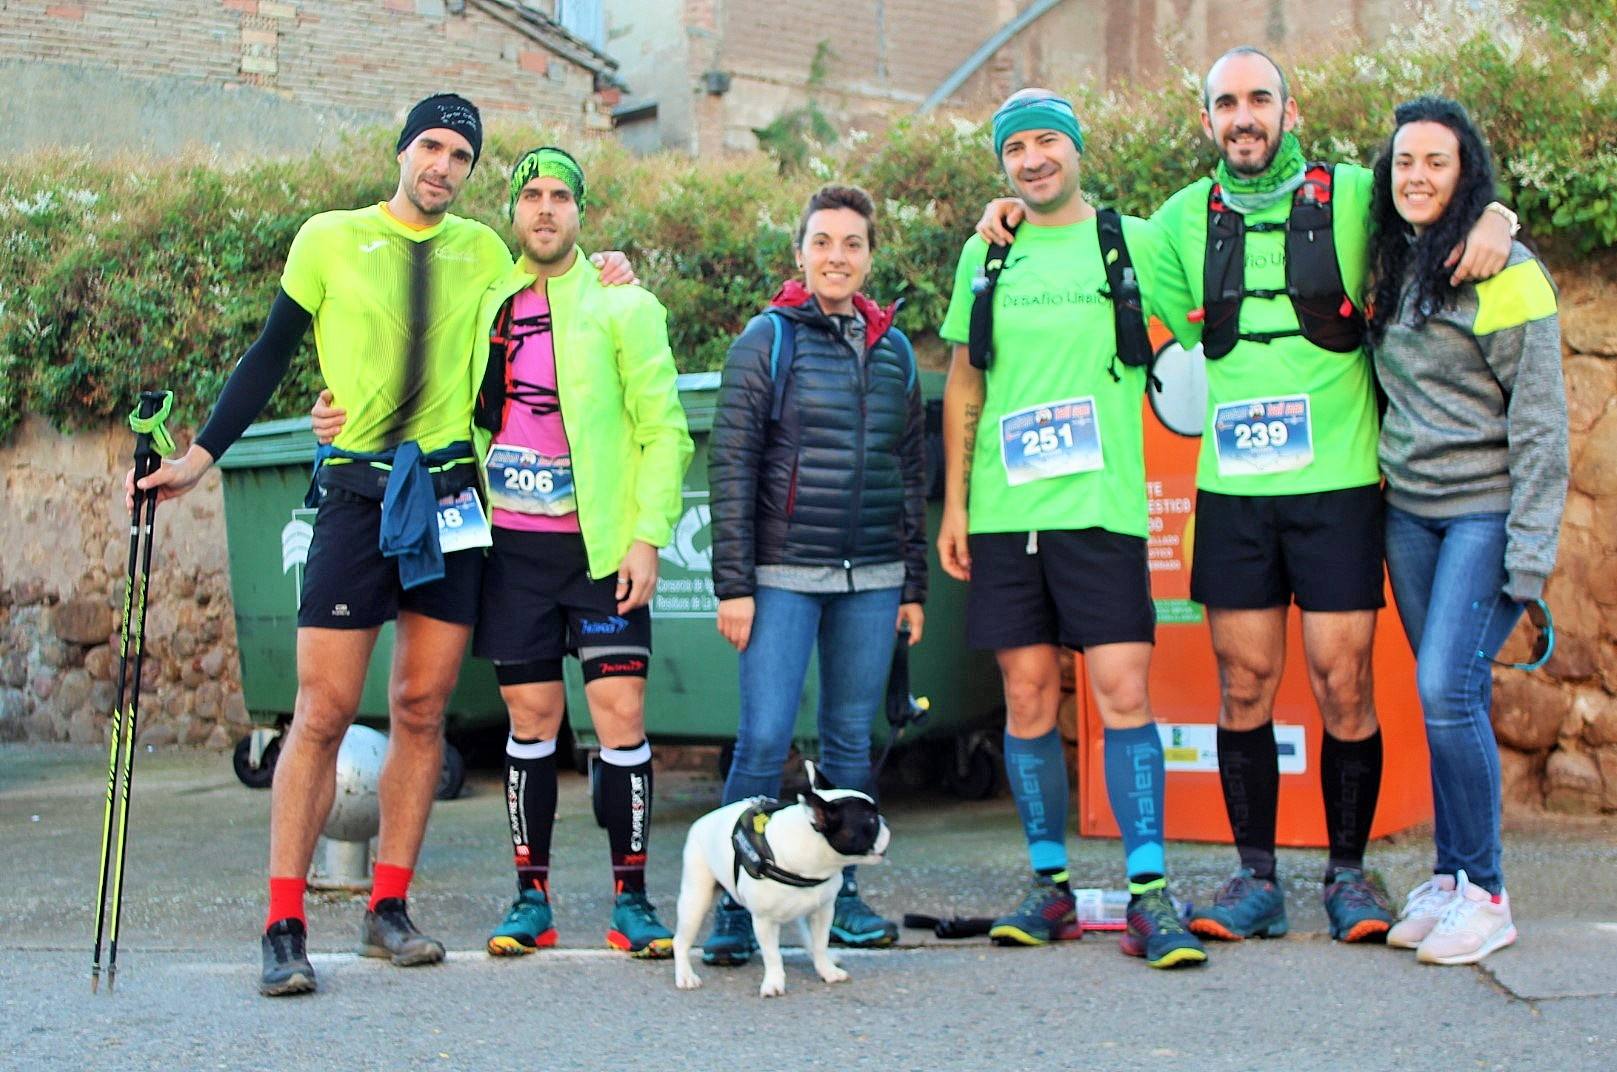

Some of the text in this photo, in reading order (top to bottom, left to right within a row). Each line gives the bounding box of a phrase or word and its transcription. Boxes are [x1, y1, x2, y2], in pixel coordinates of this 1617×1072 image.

[1021, 422, 1074, 457] 251
[1233, 420, 1289, 450] 239
[504, 466, 554, 494] 206
[1147, 481, 1163, 498] TE
